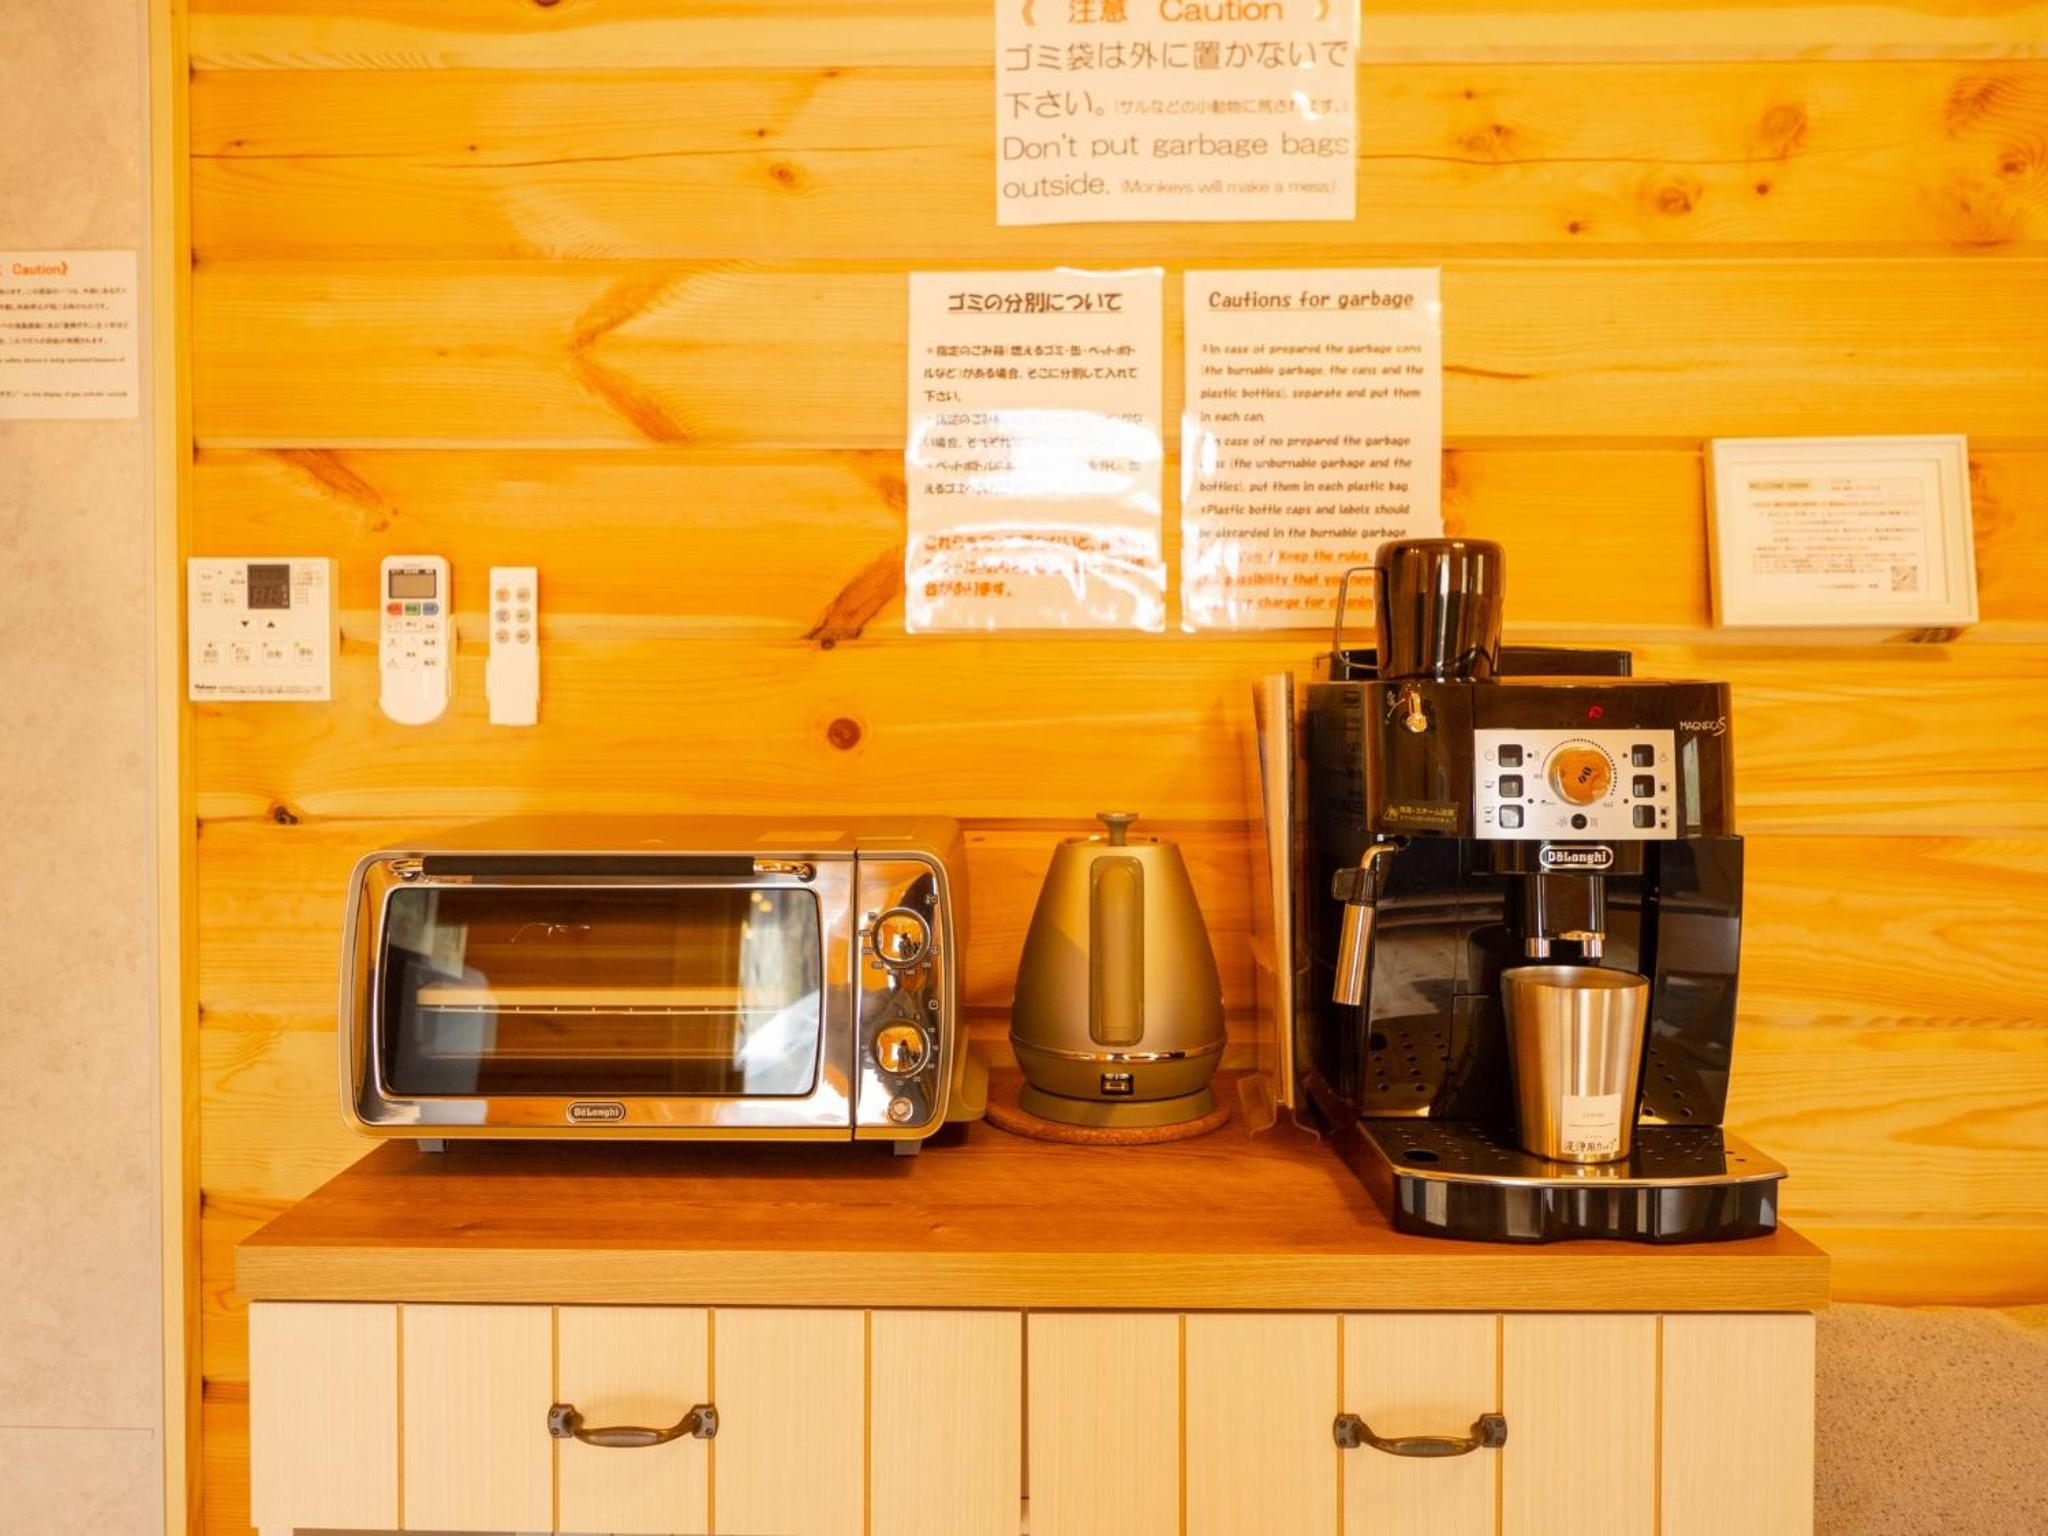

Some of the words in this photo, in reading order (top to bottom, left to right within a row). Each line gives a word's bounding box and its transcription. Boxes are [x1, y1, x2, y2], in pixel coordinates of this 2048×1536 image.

[1160, 0, 1284, 22] Caution
[1004, 41, 1348, 71] ゴミ袋は外に置かないで
[1004, 90, 1105, 119] 下さい。
[1003, 134, 1076, 160] Don't
[1092, 135, 1139, 159] put
[1153, 134, 1268, 158] garbage
[1282, 132, 1349, 157] bags
[1003, 173, 1110, 199] outside.
[1198, 180, 1223, 194] will
[1226, 180, 1270, 193] make
[1275, 183, 1284, 193] a
[948, 292, 1122, 312] ゴミの分別について
[1209, 291, 1292, 308] Cautions
[1299, 291, 1330, 307] for
[1338, 290, 1414, 310] garbage
[1225, 346, 1248, 354] case
[1253, 344, 1265, 354] of
[1269, 344, 1321, 355] prepared
[1326, 344, 1343, 353] the
[1348, 344, 1392, 355] garbage
[1396, 345, 1421, 353] cans
[1227, 365, 1274, 375] burnable
[1330, 365, 1348, 374] the
[1382, 365, 1401, 374] and
[1406, 365, 1423, 374] the
[1201, 388, 1237, 400] plastic
[1293, 388, 1342, 399] separate
[1346, 388, 1365, 398] and
[1370, 388, 1388, 400] put
[1393, 388, 1420, 398] them
[1201, 412, 1210, 422] in
[1215, 412, 1239, 422] each
[1224, 438, 1248, 446] case
[1253, 436, 1266, 446] of
[1269, 438, 1283, 446] no
[1287, 436, 1338, 448] prepared
[1344, 435, 1361, 446] the
[1365, 436, 1410, 447] garbage
[1256, 458, 1316, 468] unburnable
[1321, 458, 1365, 470] garbage
[1369, 458, 1389, 468] and
[1394, 458, 1411, 468] the
[1250, 481, 1268, 492] put
[1273, 481, 1300, 492] them
[1303, 481, 1313, 491] in
[1318, 481, 1343, 491] each
[1348, 481, 1384, 493] plastic
[1250, 504, 1282, 514] bottle
[1286, 506, 1310, 516] caps
[1316, 504, 1335, 514] and
[1340, 503, 1370, 514] labels
[1375, 504, 1410, 514] should
[1274, 527, 1284, 537] in
[1289, 527, 1306, 537] the
[1310, 527, 1357, 537] burnable
[1314, 550, 1334, 562] the
[1294, 573, 1320, 584] that
[1258, 598, 1299, 609] charge
[1306, 597, 1325, 608] for
